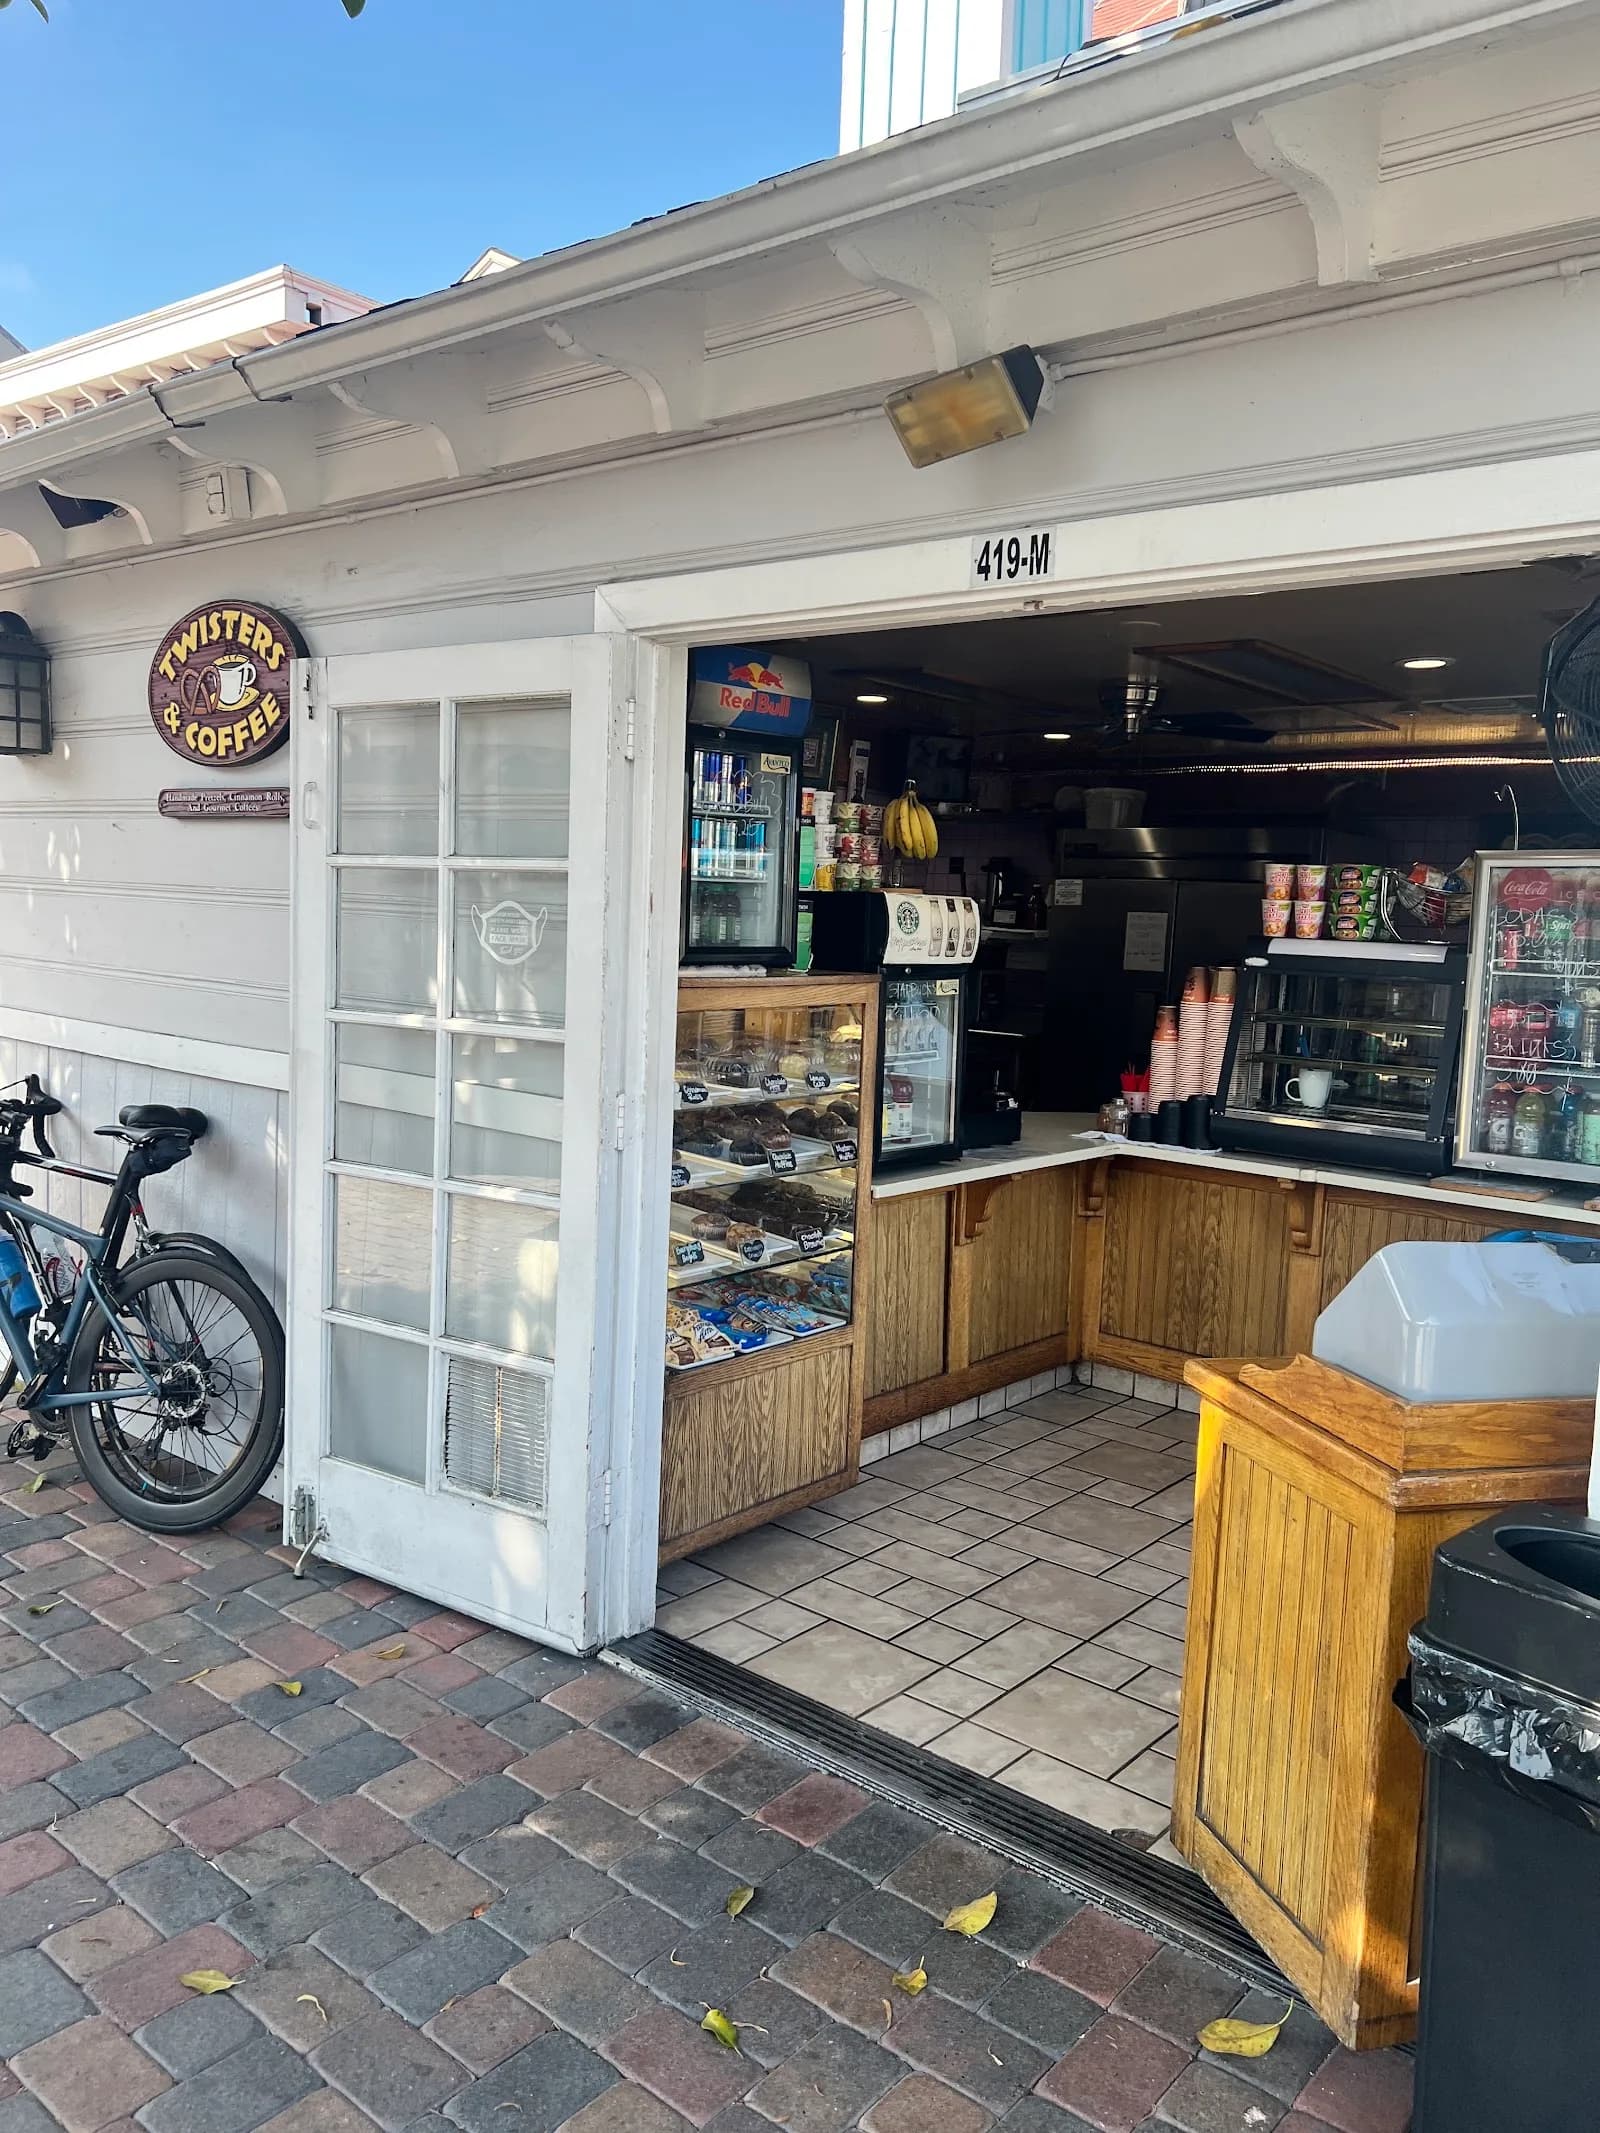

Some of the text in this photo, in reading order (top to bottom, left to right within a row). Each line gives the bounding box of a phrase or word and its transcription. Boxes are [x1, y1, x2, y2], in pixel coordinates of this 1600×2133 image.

[977, 533, 1050, 581] 419-M
[158, 610, 286, 681] TWISTERS
[719, 687, 791, 718] Red Bull
[163, 692, 281, 756] & COFFEE
[189, 803, 200, 812] And
[229, 791, 263, 801] Cinnamon
